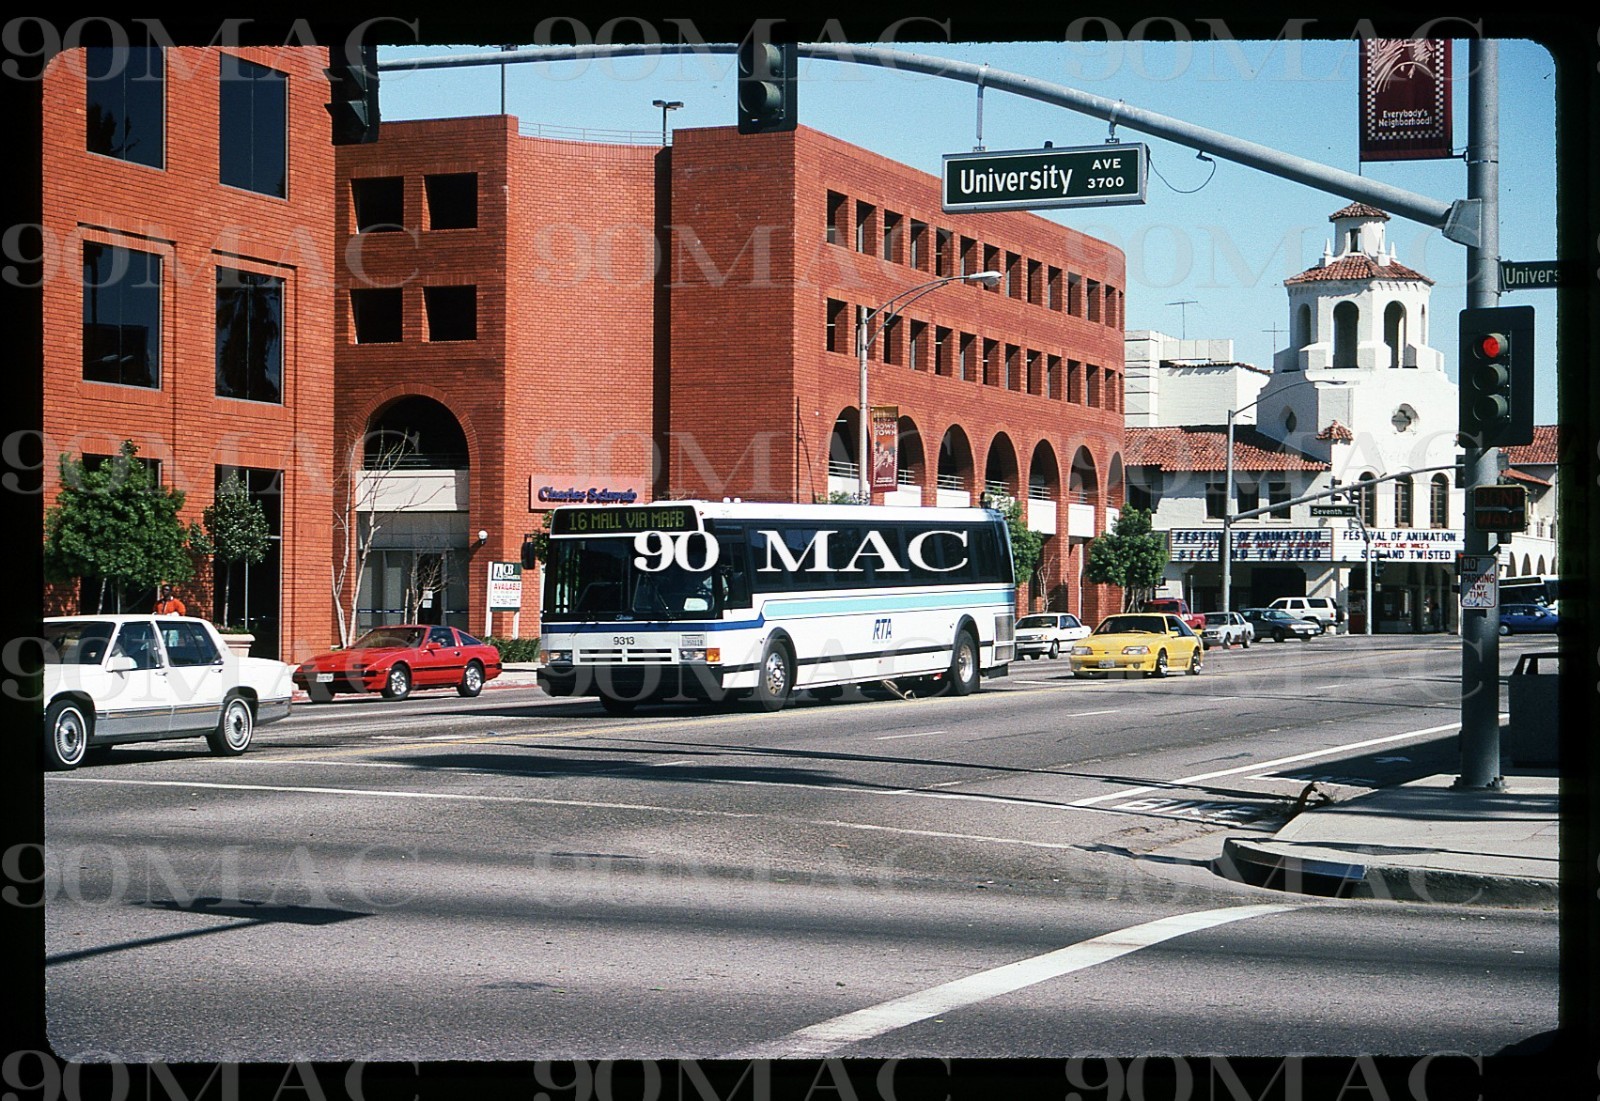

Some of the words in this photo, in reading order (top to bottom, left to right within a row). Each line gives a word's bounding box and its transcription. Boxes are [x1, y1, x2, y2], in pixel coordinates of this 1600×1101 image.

[1383, 109, 1428, 118] Everybody's
[1378, 116, 1433, 128] Neighborhood!
[1092, 158, 1121, 170] AVE
[960, 164, 1074, 195] University
[1087, 176, 1125, 189] 3700
[538, 486, 586, 502] Charles
[1312, 507, 1343, 515] Seventh
[569, 512, 588, 530] 16
[591, 512, 622, 529] MALL
[626, 511, 648, 528] VIA
[651, 511, 685, 528] MAFB
[1177, 531, 1224, 541] FESTIV
[1238, 531, 1250, 541] OF
[1254, 531, 1322, 541] ANIMATION
[1343, 531, 1388, 541] FESTVAL
[1390, 531, 1402, 541] OF
[1406, 532, 1456, 542] ANIMATION
[1230, 549, 1248, 559] ND
[1258, 549, 1321, 559] TWISTED
[1387, 549, 1405, 559] AND
[1410, 550, 1451, 560] TWISTED
[1463, 558, 1477, 570] NO
[1463, 573, 1495, 584] PARKING
[872, 618, 892, 640] RTA
[613, 636, 635, 646] 9313
